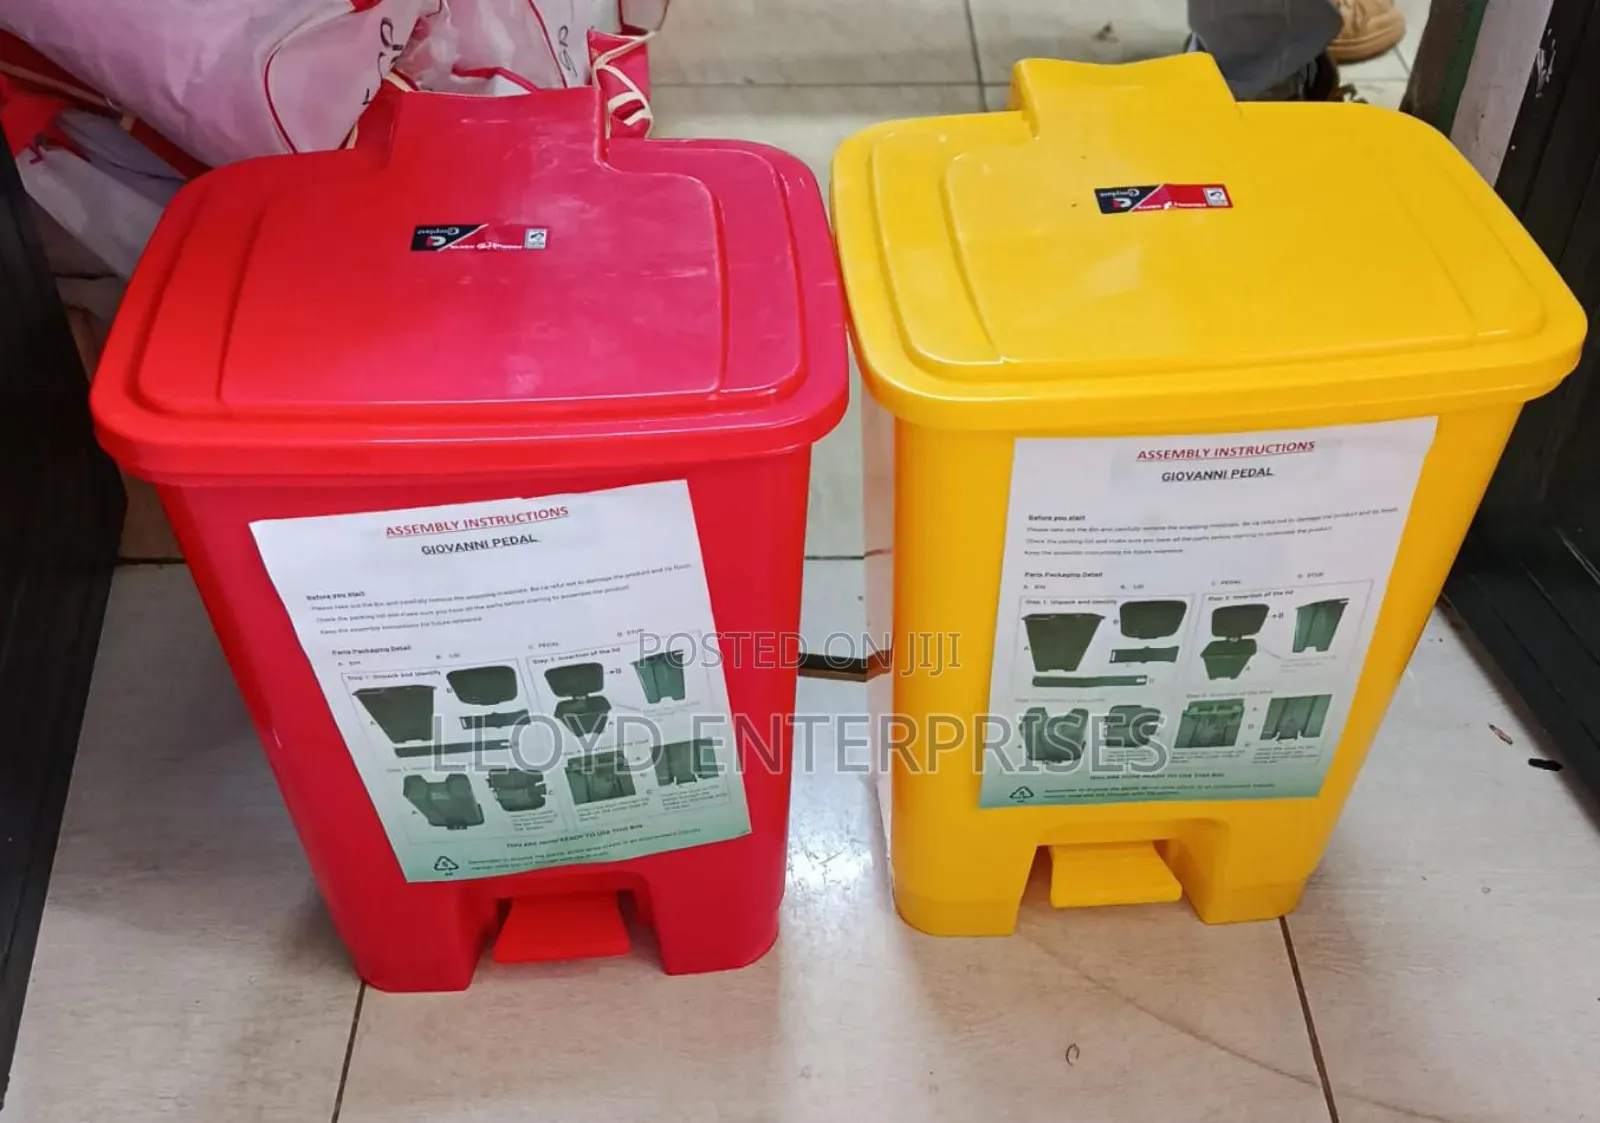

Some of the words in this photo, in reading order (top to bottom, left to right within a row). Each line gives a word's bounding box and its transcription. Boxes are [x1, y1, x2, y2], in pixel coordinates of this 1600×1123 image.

[1136, 448, 1211, 462] ASSEMBLY
[1214, 440, 1316, 458] INSTRUCTIONS
[1161, 469, 1228, 483] GIOVANNI
[1231, 466, 1274, 480] PEDAL
[386, 519, 460, 538] ASSEMBLY
[463, 506, 569, 530] INSTRUCTIONS
[421, 539, 490, 556] GIOVANNI
[492, 533, 538, 549] PEDAL
